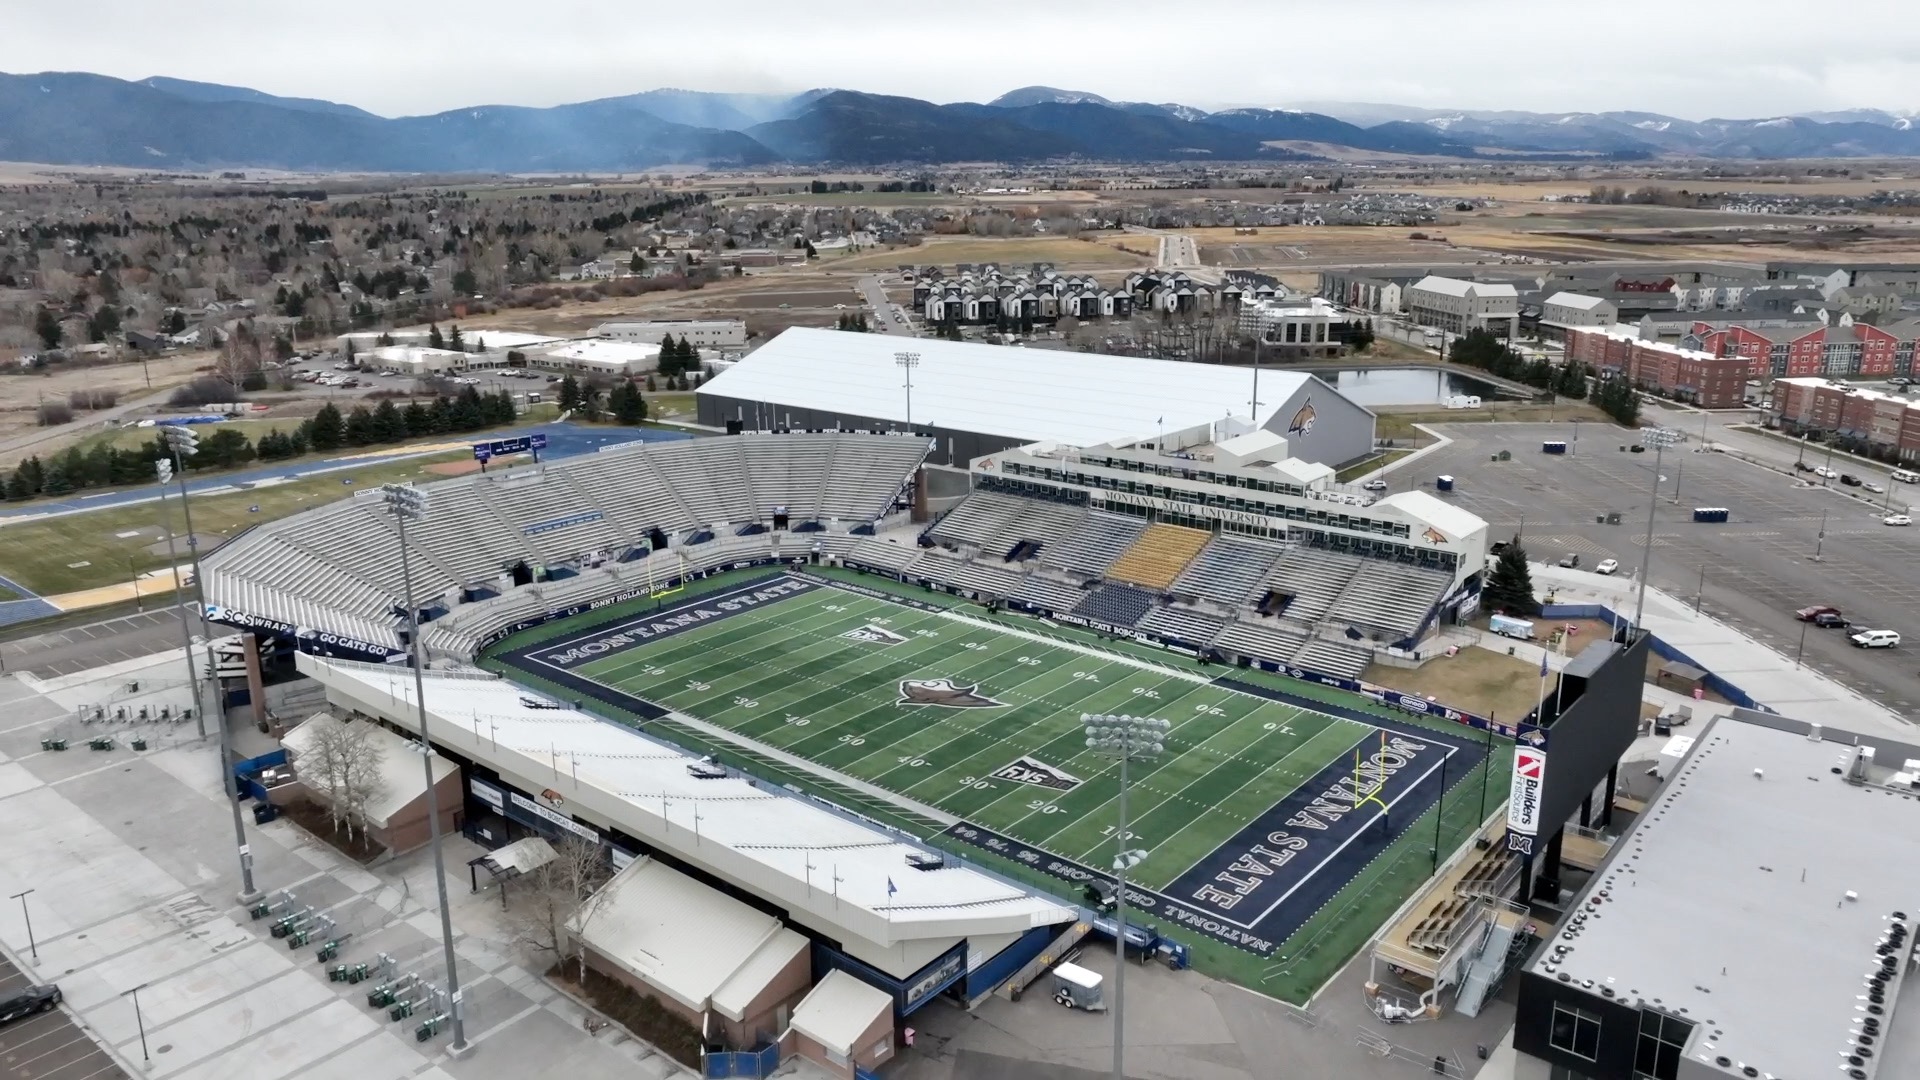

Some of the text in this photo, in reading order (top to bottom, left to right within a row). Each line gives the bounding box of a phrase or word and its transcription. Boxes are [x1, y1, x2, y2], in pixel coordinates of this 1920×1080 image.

[1104, 491, 1272, 527] MONTANA STATE UNIVERSITY
[590, 581, 670, 610] SONNY HOLLAND ZONE
[222, 608, 254, 625] SCS
[548, 606, 723, 665] MONTANA
[717, 579, 811, 611] STATE
[1052, 611, 1089, 628] MONTANA
[1113, 626, 1148, 641] BOBCATS
[320, 633, 389, 656] GO CATS GO!
[1016, 656, 1042, 666] 50
[642, 665, 666, 676] 10
[1072, 670, 1095, 682] 40
[685, 680, 711, 692] 20
[1131, 687, 1156, 698] 30
[734, 697, 760, 709] 30
[1194, 704, 1222, 716] 20
[1402, 697, 1425, 711] conoco
[785, 714, 811, 727] 40
[1263, 722, 1291, 734] 10
[837, 734, 866, 747] 50
[897, 754, 926, 768] 40
[996, 765, 1049, 784] SKY
[959, 776, 990, 790] 30
[1511, 775, 1526, 823] FirstSource
[1521, 779, 1539, 826] Builders
[1026, 800, 1059, 815] 20
[512, 795, 538, 812] WELCOME
[539, 807, 548, 817] TO
[547, 812, 570, 828] BOBCAT
[571, 823, 598, 841] COUNTRY
[1192, 737, 1427, 911] MONTANA STATE
[1164, 905, 1273, 952] NATIONAL
